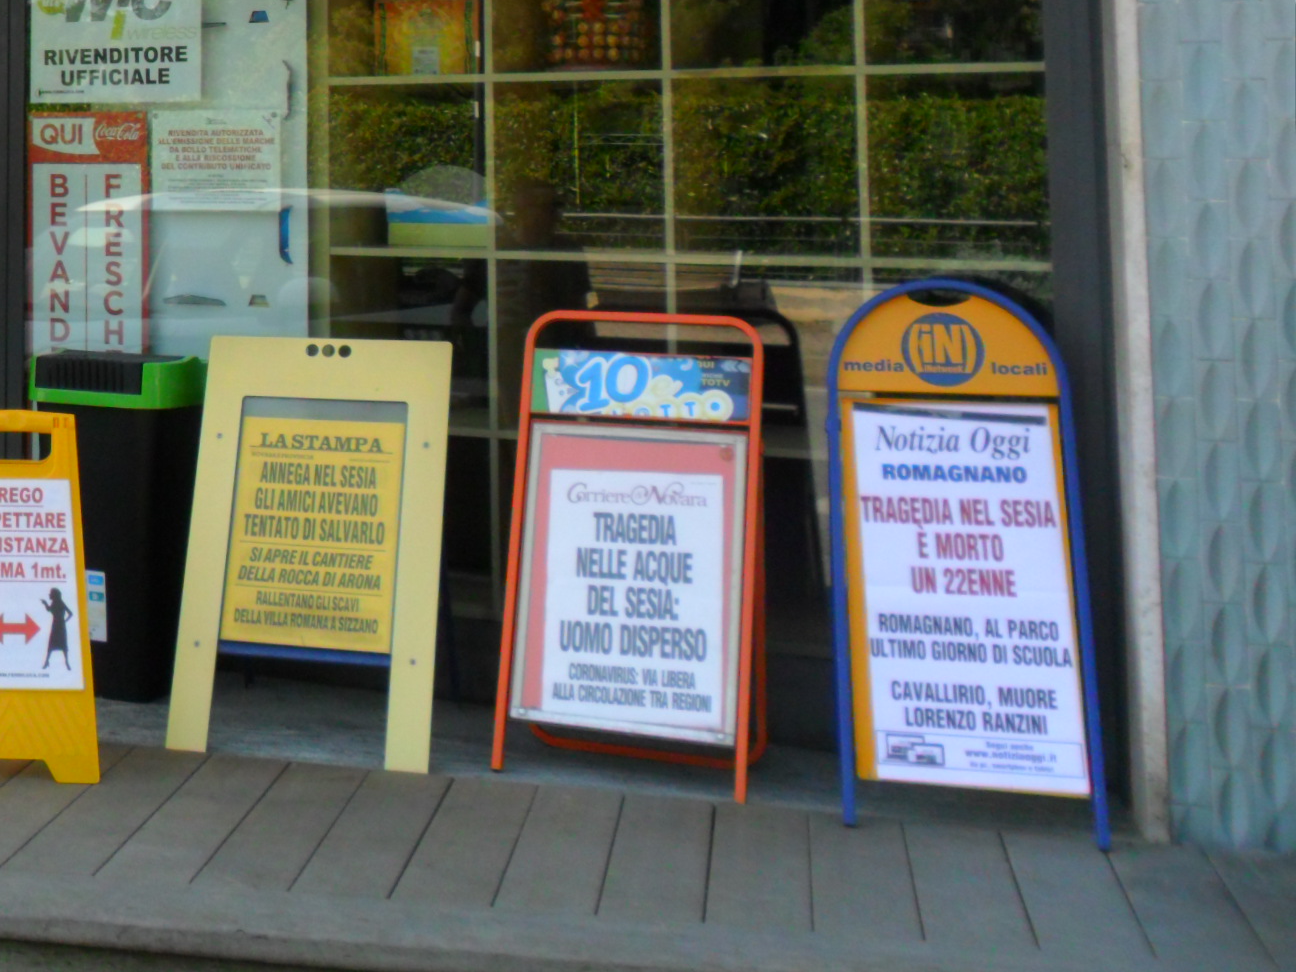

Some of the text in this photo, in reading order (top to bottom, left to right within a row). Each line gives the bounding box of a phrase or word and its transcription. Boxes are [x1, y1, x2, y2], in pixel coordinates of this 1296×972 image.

[44, 46, 188, 65] RIVENDITORE
[61, 68, 170, 86] UFFICIALE
[40, 124, 82, 144] QUI
[49, 174, 70, 352] BEVAND
[104, 174, 124, 353] FRESCH
[844, 360, 904, 372] media
[991, 362, 1047, 375] locali
[575, 355, 651, 412] 10
[261, 433, 383, 453] LA STAMPA
[875, 424, 1030, 459] Notizia Oggi
[260, 461, 376, 489] ANNEGA NEL SESIA
[882, 464, 1026, 484] ROMAGNANO
[254, 487, 378, 516] GLI AMICI AVEVANO
[567, 482, 630, 503] Corriere
[860, 495, 1057, 528] TRAGEDIA NEL SESIA
[244, 514, 385, 545] TENTATO DI SALVARLO
[593, 512, 676, 546] TRAGEDIA
[250, 547, 374, 570] SI APRE IL CANTIERE
[936, 532, 1004, 562] MORTO
[31, 562, 66, 579] 1mt.
[238, 565, 381, 590] DELLA ROCCA DI ARONA
[576, 547, 693, 585] NELLE ACQUE
[911, 566, 1017, 597] UN 22ENNE
[256, 591, 360, 612] RALLENTANO GLI SCAVI
[586, 585, 679, 620] DEL SESIA:
[234, 608, 378, 634] DELLA VILLA ROMANA SIZZANO
[878, 613, 1059, 642] ROMAGNANO, AL PARCO
[560, 620, 706, 662] UOMO DISPERSO
[870, 638, 1072, 667] ULTIMO GIORNO DI SCUOLA
[568, 662, 696, 690] CORONAVIRUS: VIA LIBERA
[552, 682, 712, 713] ALLA CIRCOLAZIONE TRA REGIONI
[891, 680, 1057, 709] CAVALLIRIO, MUORE
[905, 706, 1047, 735] LORENZO RANZINI
